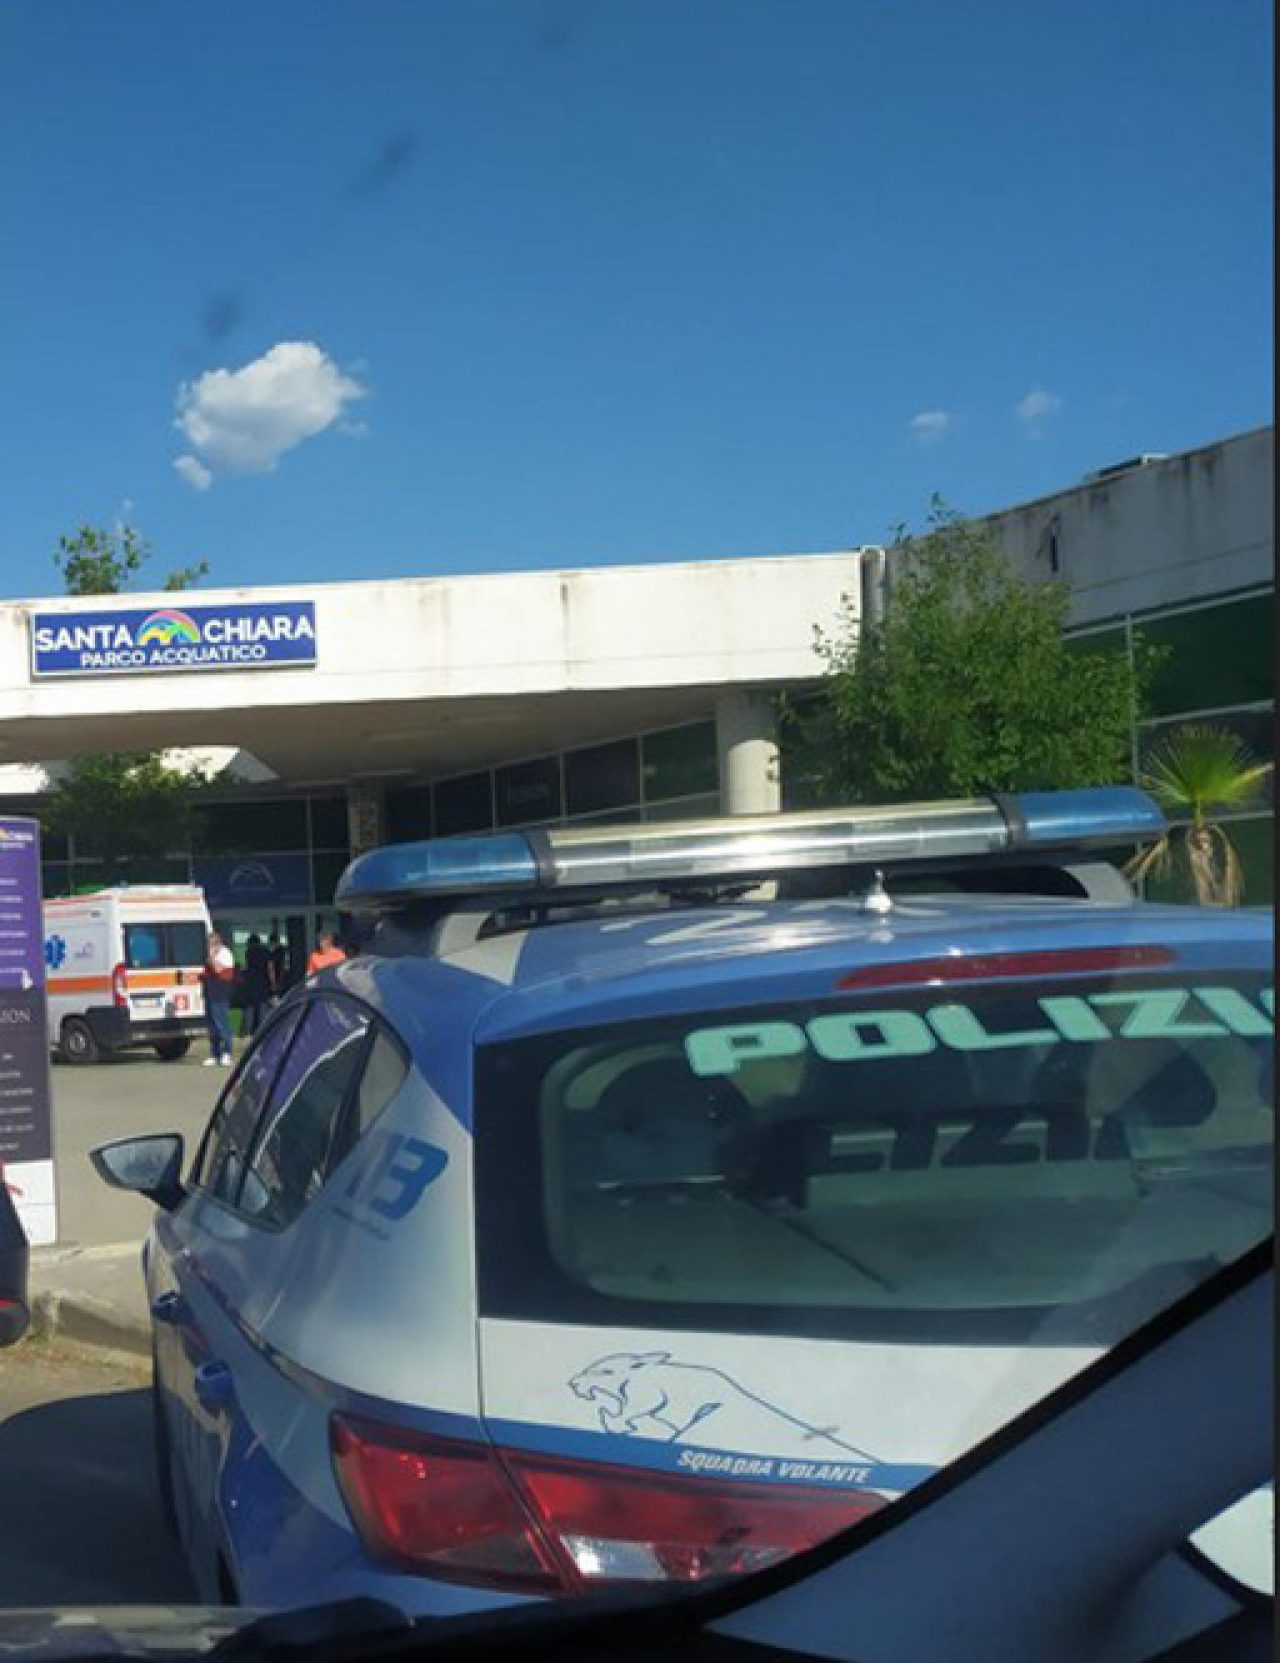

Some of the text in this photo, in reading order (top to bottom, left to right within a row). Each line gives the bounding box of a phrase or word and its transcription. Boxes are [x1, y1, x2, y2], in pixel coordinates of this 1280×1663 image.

[35, 614, 315, 651] SANTA CHIARA
[80, 644, 267, 668] PARCO ACQUATICO
[684, 987, 1274, 1076] POLIZI
[677, 1450, 872, 1484] SQUADRA VOLANTE
